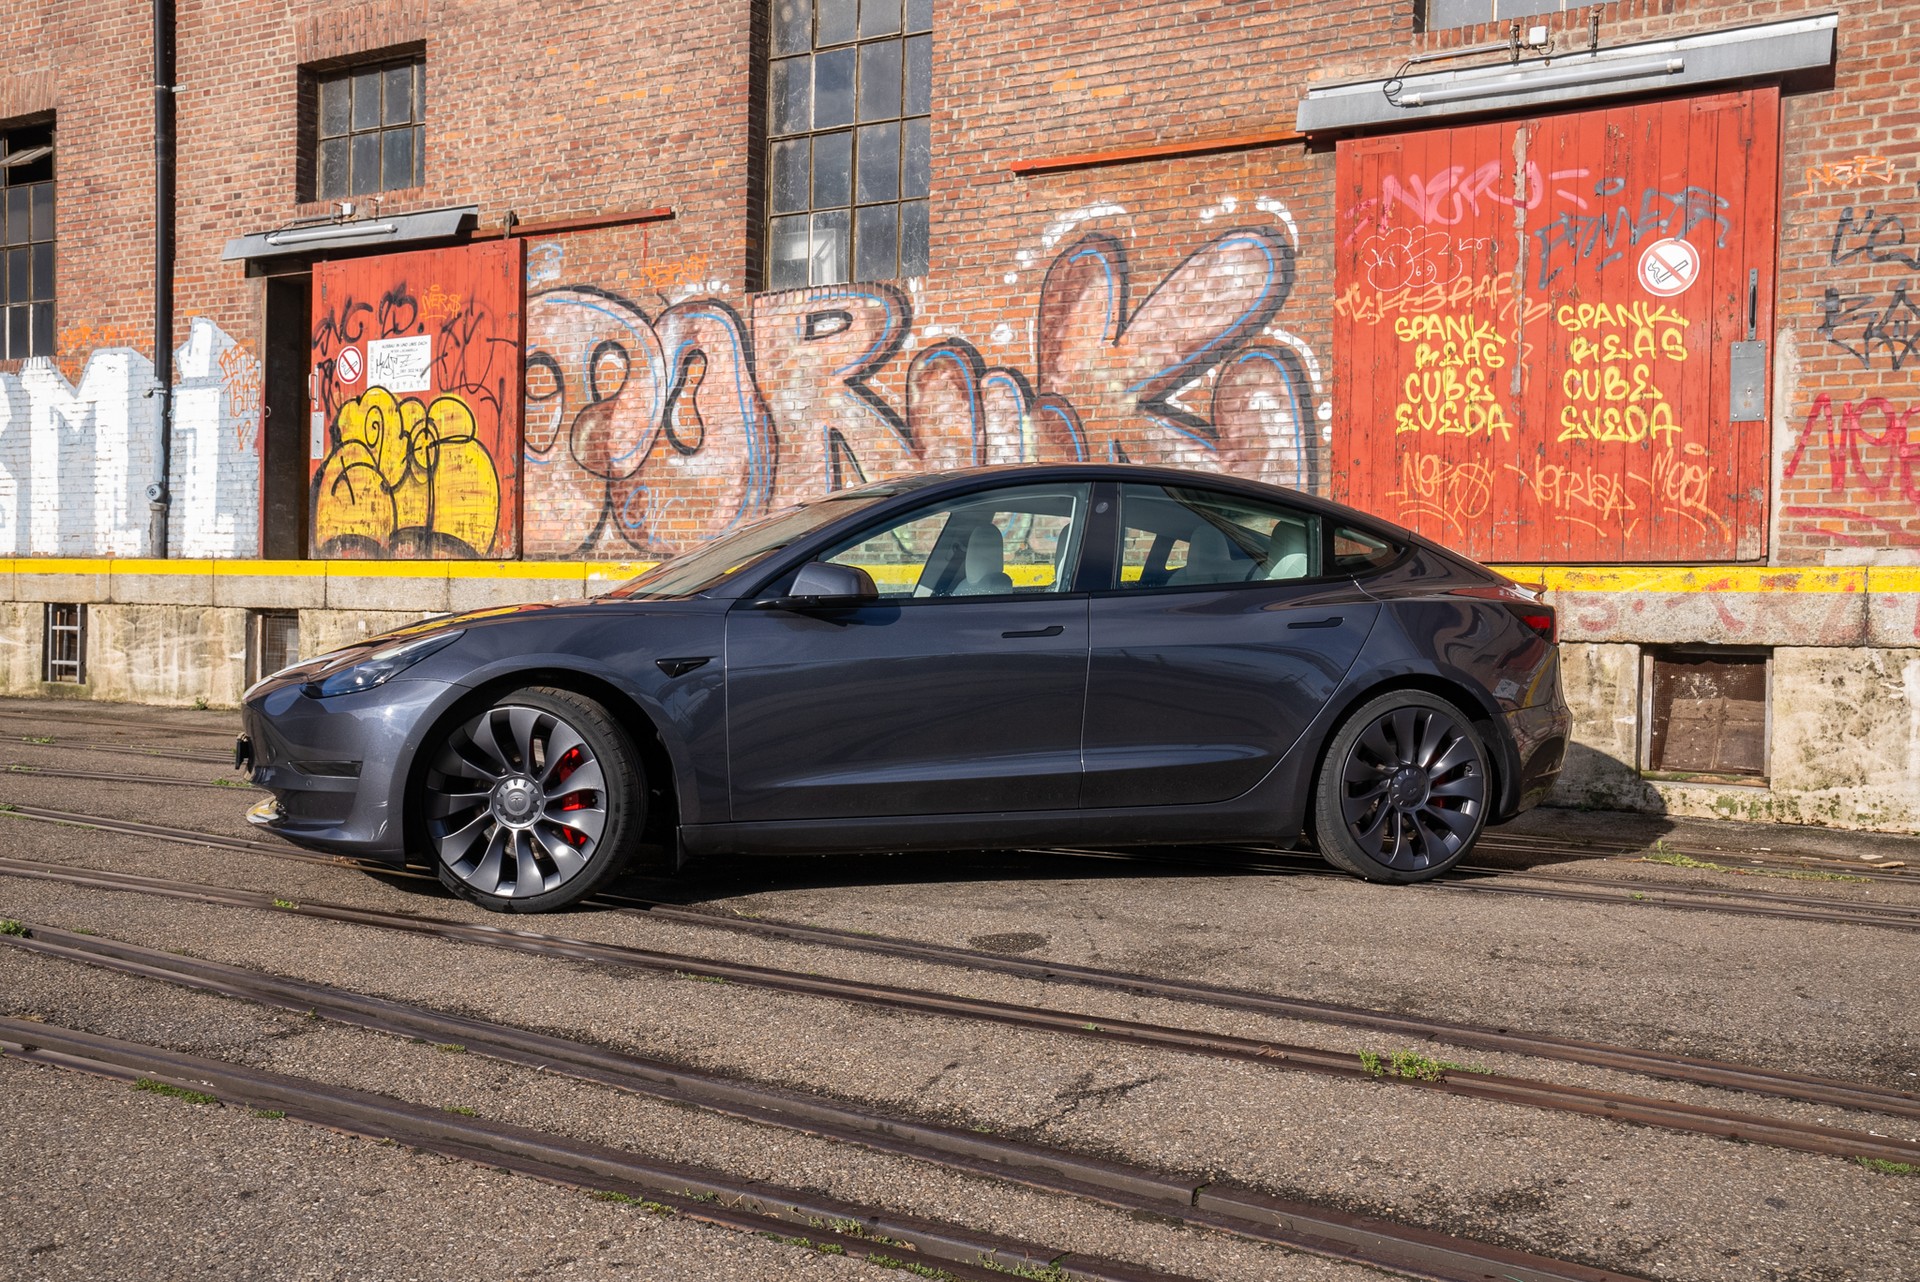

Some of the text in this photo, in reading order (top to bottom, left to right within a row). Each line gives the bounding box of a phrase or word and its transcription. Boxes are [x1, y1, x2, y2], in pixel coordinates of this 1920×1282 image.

[1395, 314, 1507, 346] SPANK
[1557, 301, 1690, 331] SPANK
[1405, 367, 1496, 403] CUBE
[1563, 364, 1663, 402] CUBE
[1557, 402, 1683, 447] EVEDA
